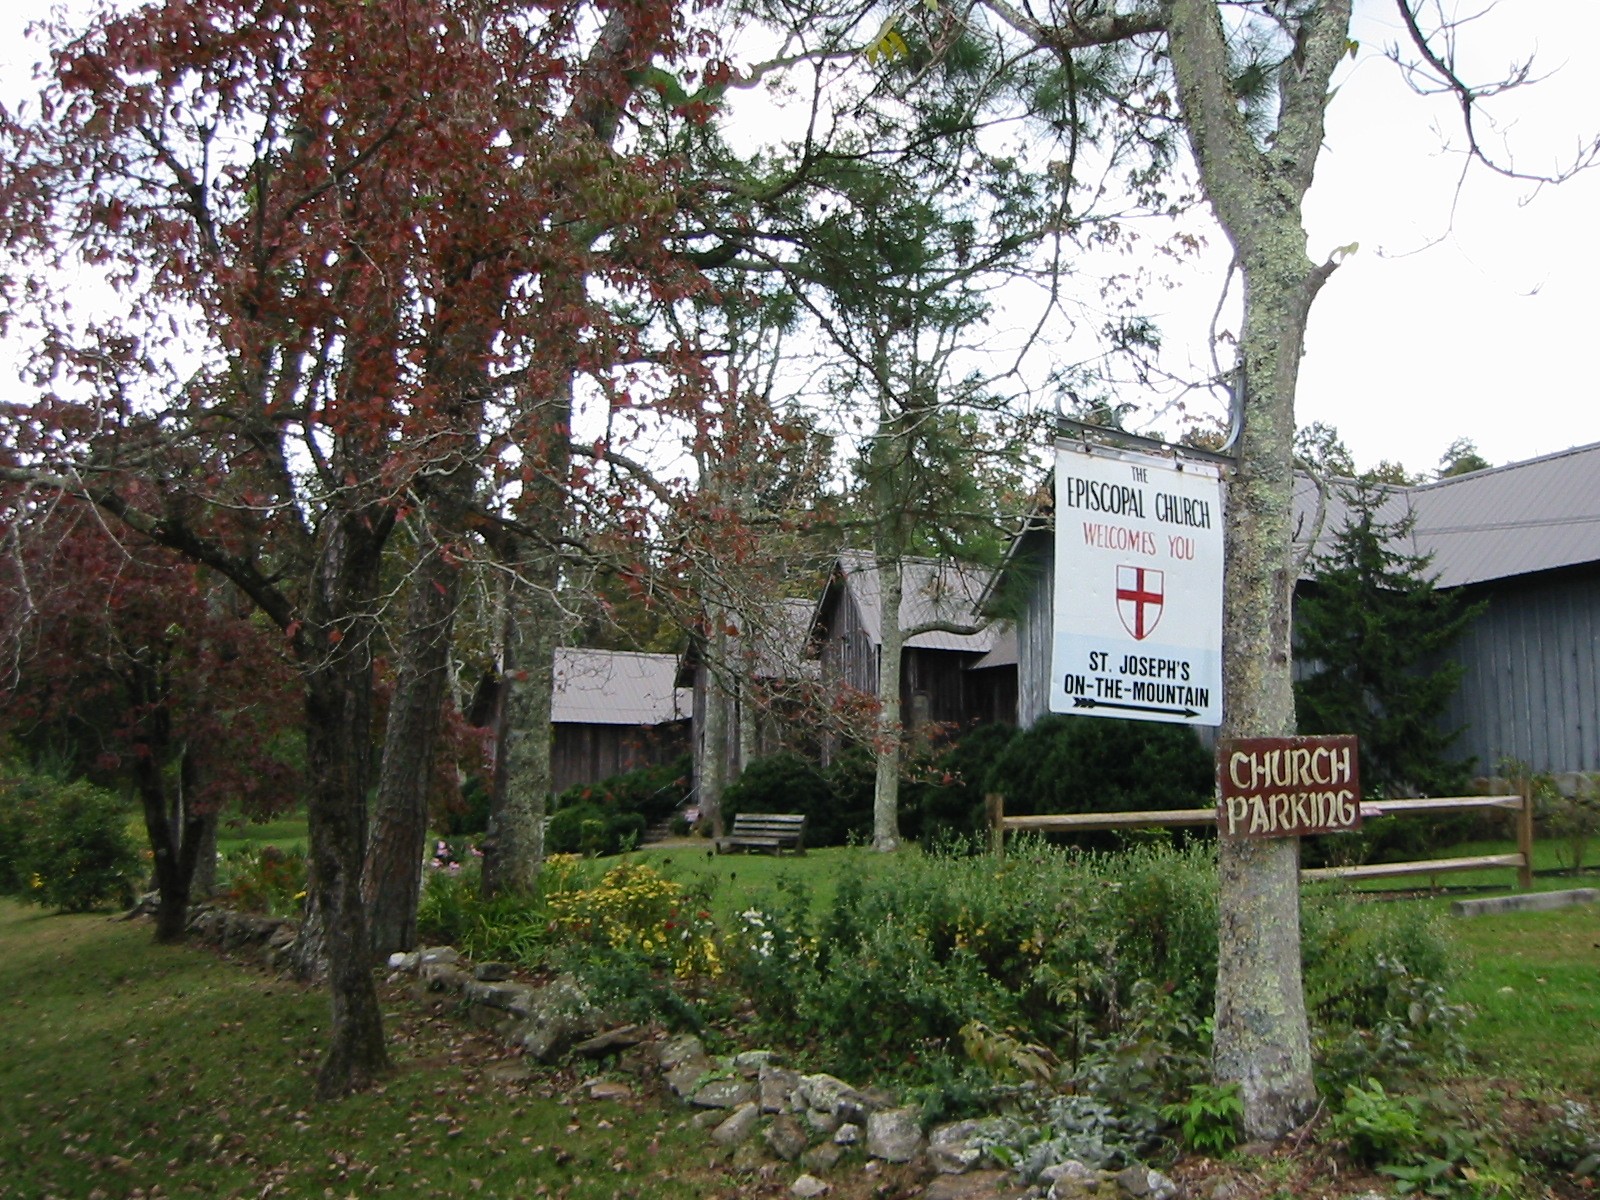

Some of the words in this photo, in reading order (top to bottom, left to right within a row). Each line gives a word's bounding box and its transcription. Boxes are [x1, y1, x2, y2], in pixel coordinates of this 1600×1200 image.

[1131, 465, 1149, 483] THE
[1067, 477, 1146, 519] EPISCOPAL
[1155, 492, 1211, 529] CHURCH
[1083, 522, 1157, 555] WELCOMES
[1168, 535, 1195, 560] YOU
[1089, 651, 1112, 673] ST.
[1119, 654, 1190, 681] JOSEPH'S
[1064, 673, 1209, 708] ON-THE-MOUNTAIN
[1229, 746, 1350, 790] CHURCH
[1226, 789, 1356, 835] PARKING
